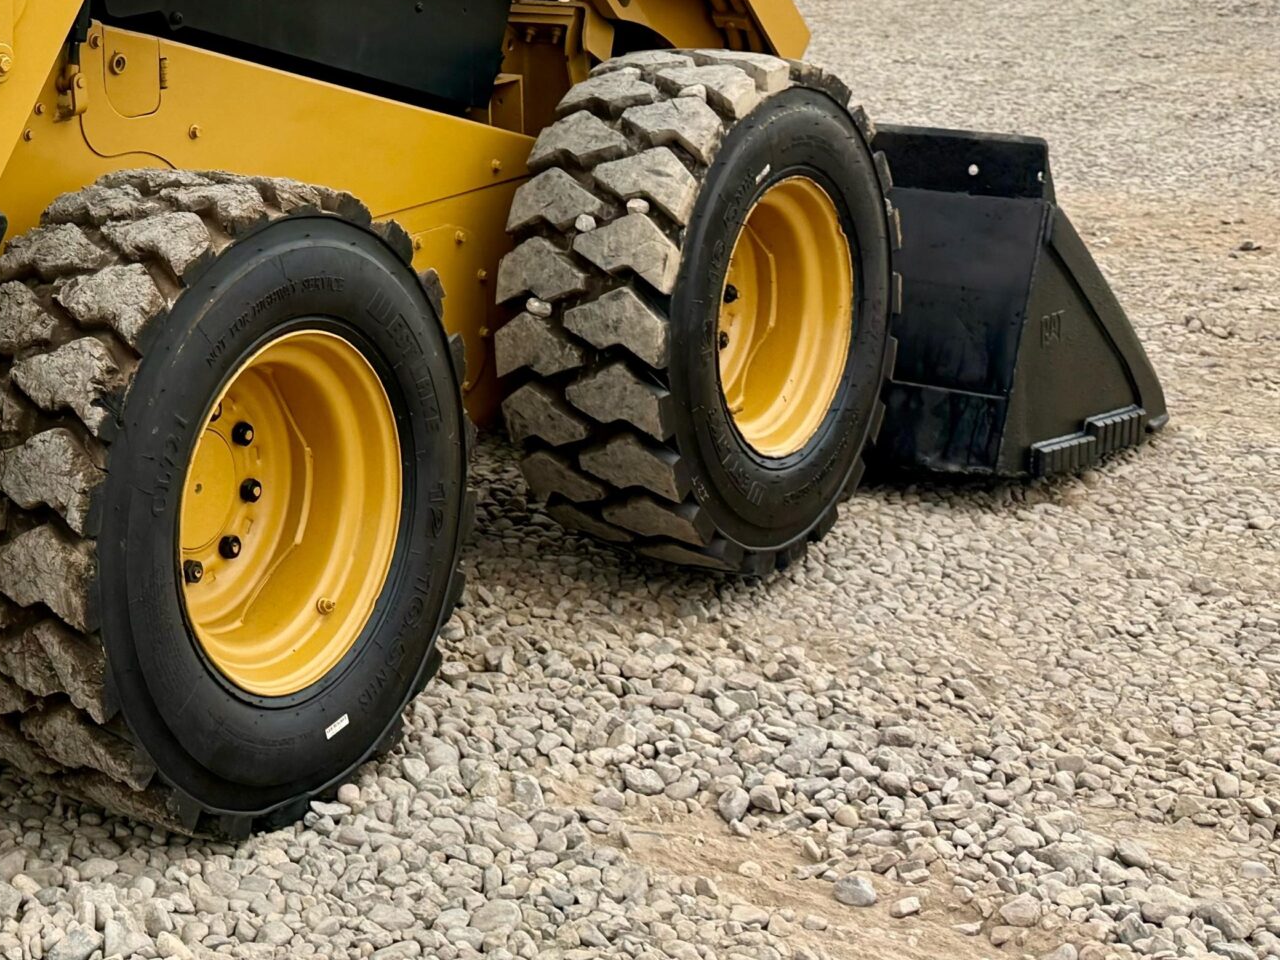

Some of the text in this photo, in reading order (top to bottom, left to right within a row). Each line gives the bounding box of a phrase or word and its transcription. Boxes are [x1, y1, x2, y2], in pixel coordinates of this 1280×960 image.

[205, 334, 227, 369] NOT
[228, 311, 251, 339] FOR
[300, 276, 345, 293] SERVICE
[1041, 309, 1066, 350] CAT
